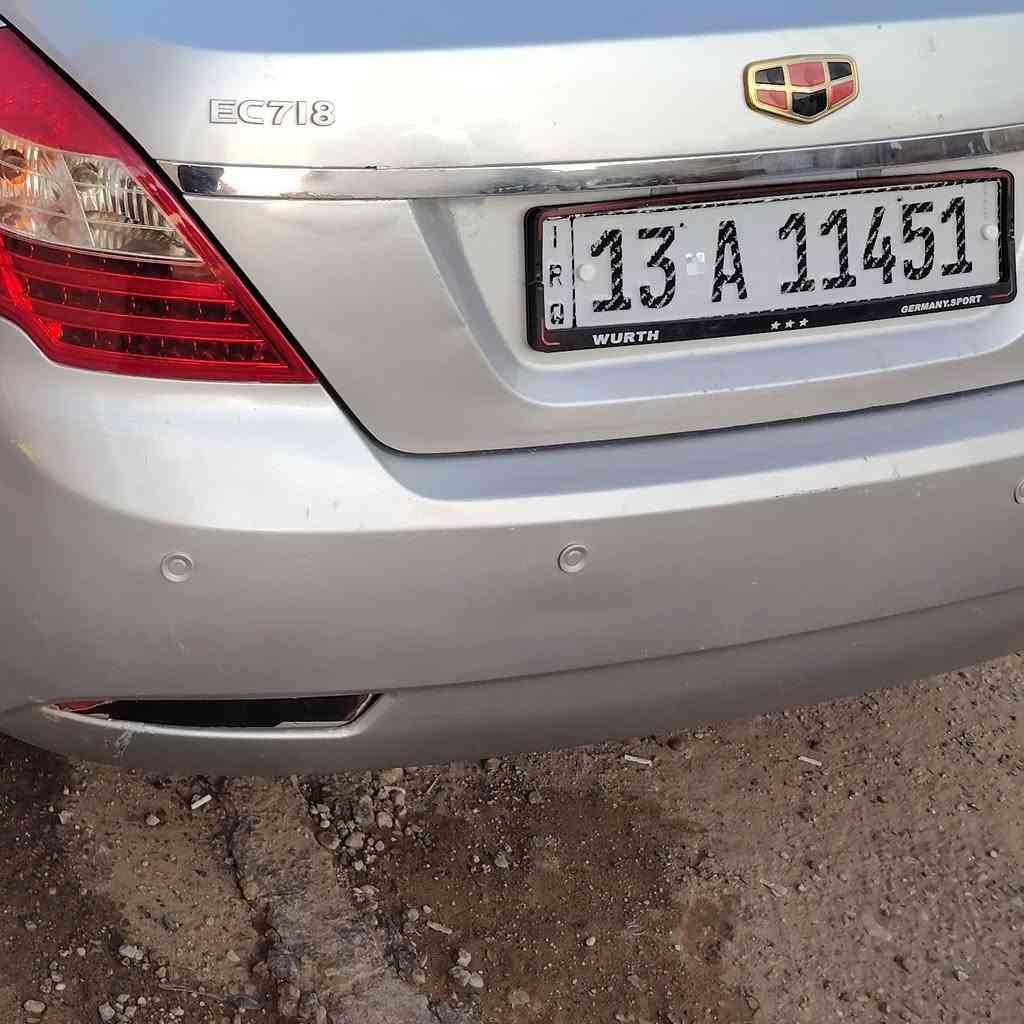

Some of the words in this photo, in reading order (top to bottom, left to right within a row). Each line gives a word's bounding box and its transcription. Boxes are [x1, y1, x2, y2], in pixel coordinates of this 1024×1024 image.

[209, 98, 336, 127] EC718
[591, 226, 676, 312] 13
[712, 220, 747, 303] A
[778, 196, 973, 293] 11451
[592, 330, 660, 346] WURTH
